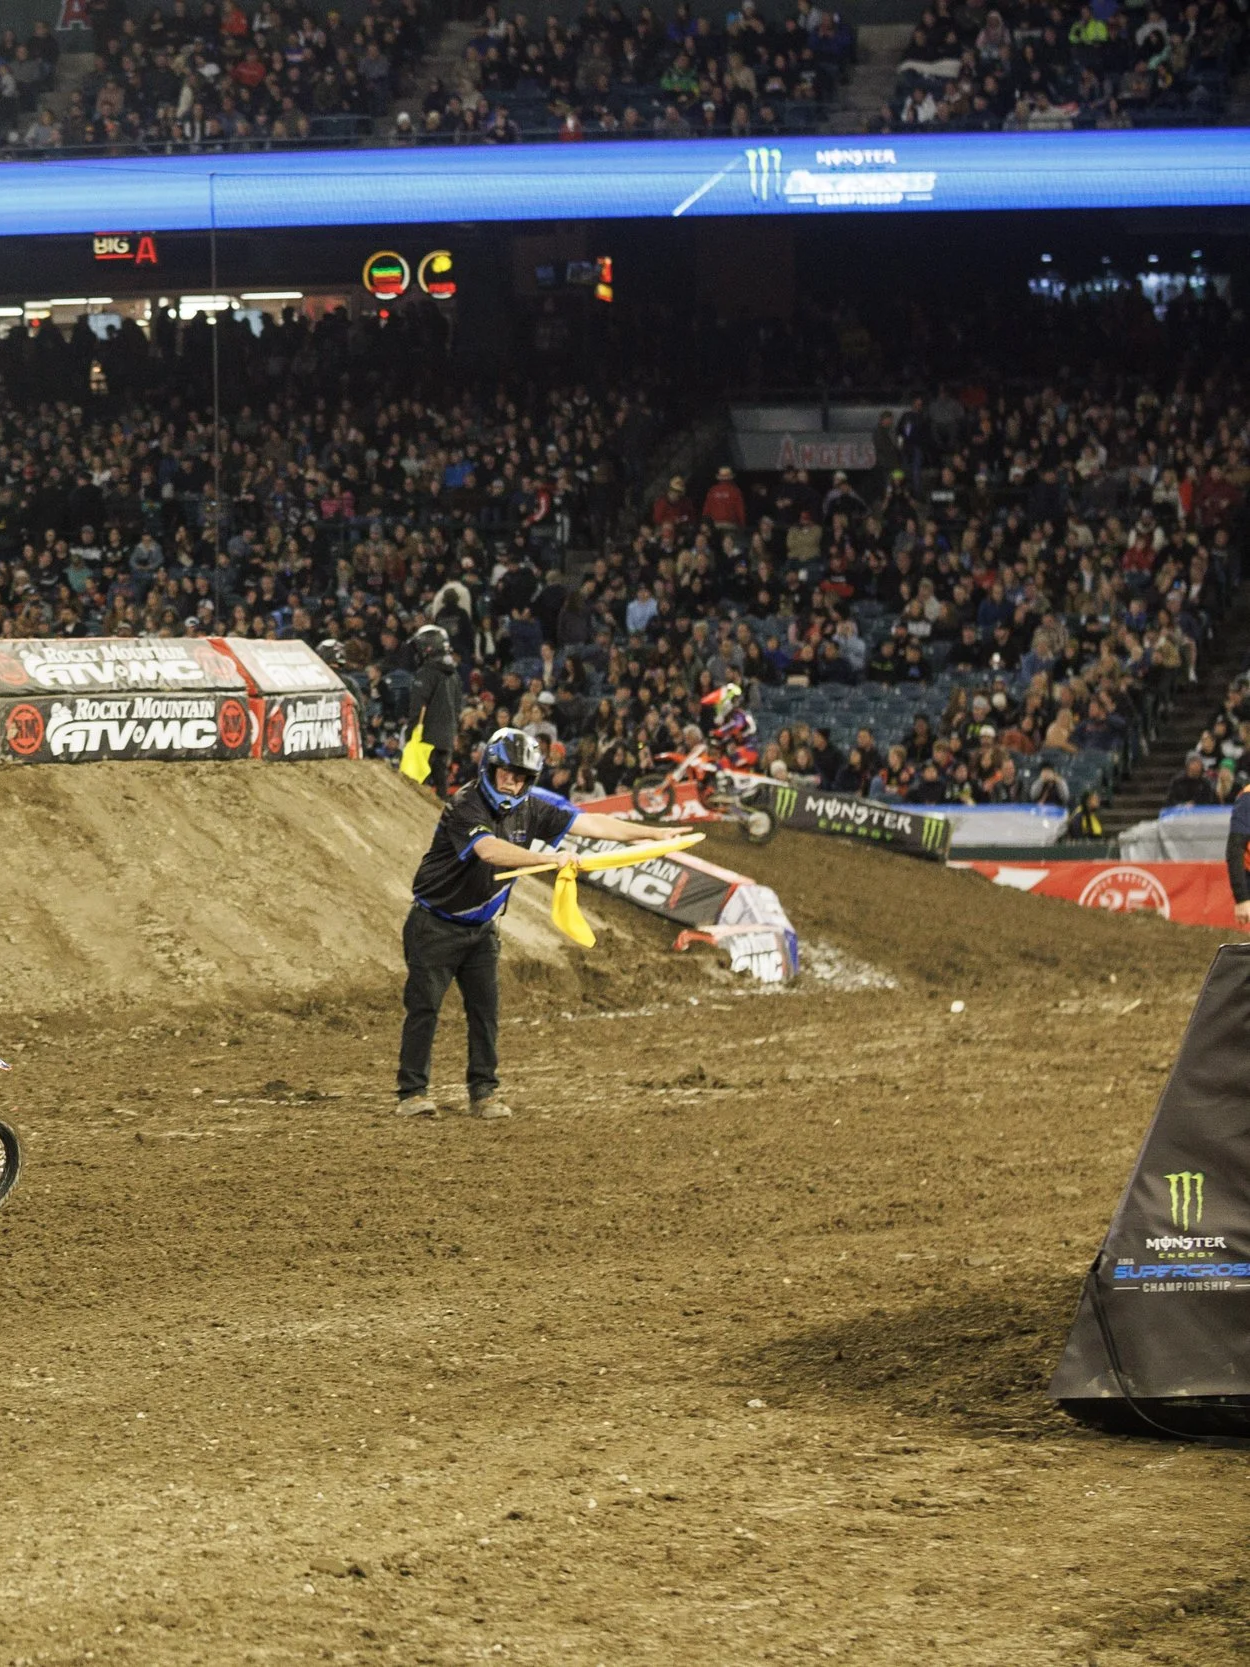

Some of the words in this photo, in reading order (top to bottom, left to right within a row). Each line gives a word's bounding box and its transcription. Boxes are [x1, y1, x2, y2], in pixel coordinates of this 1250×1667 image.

[93, 236, 130, 254] BIG
[72, 699, 129, 721] ROCKY
[131, 697, 216, 719] MOUNTAIN
[805, 796, 912, 835] MONSTER
[818, 818, 894, 842] ENERGY
[1145, 1235, 1227, 1250] MONSTER
[1142, 1281, 1232, 1293] CHAMPIONSHIP
